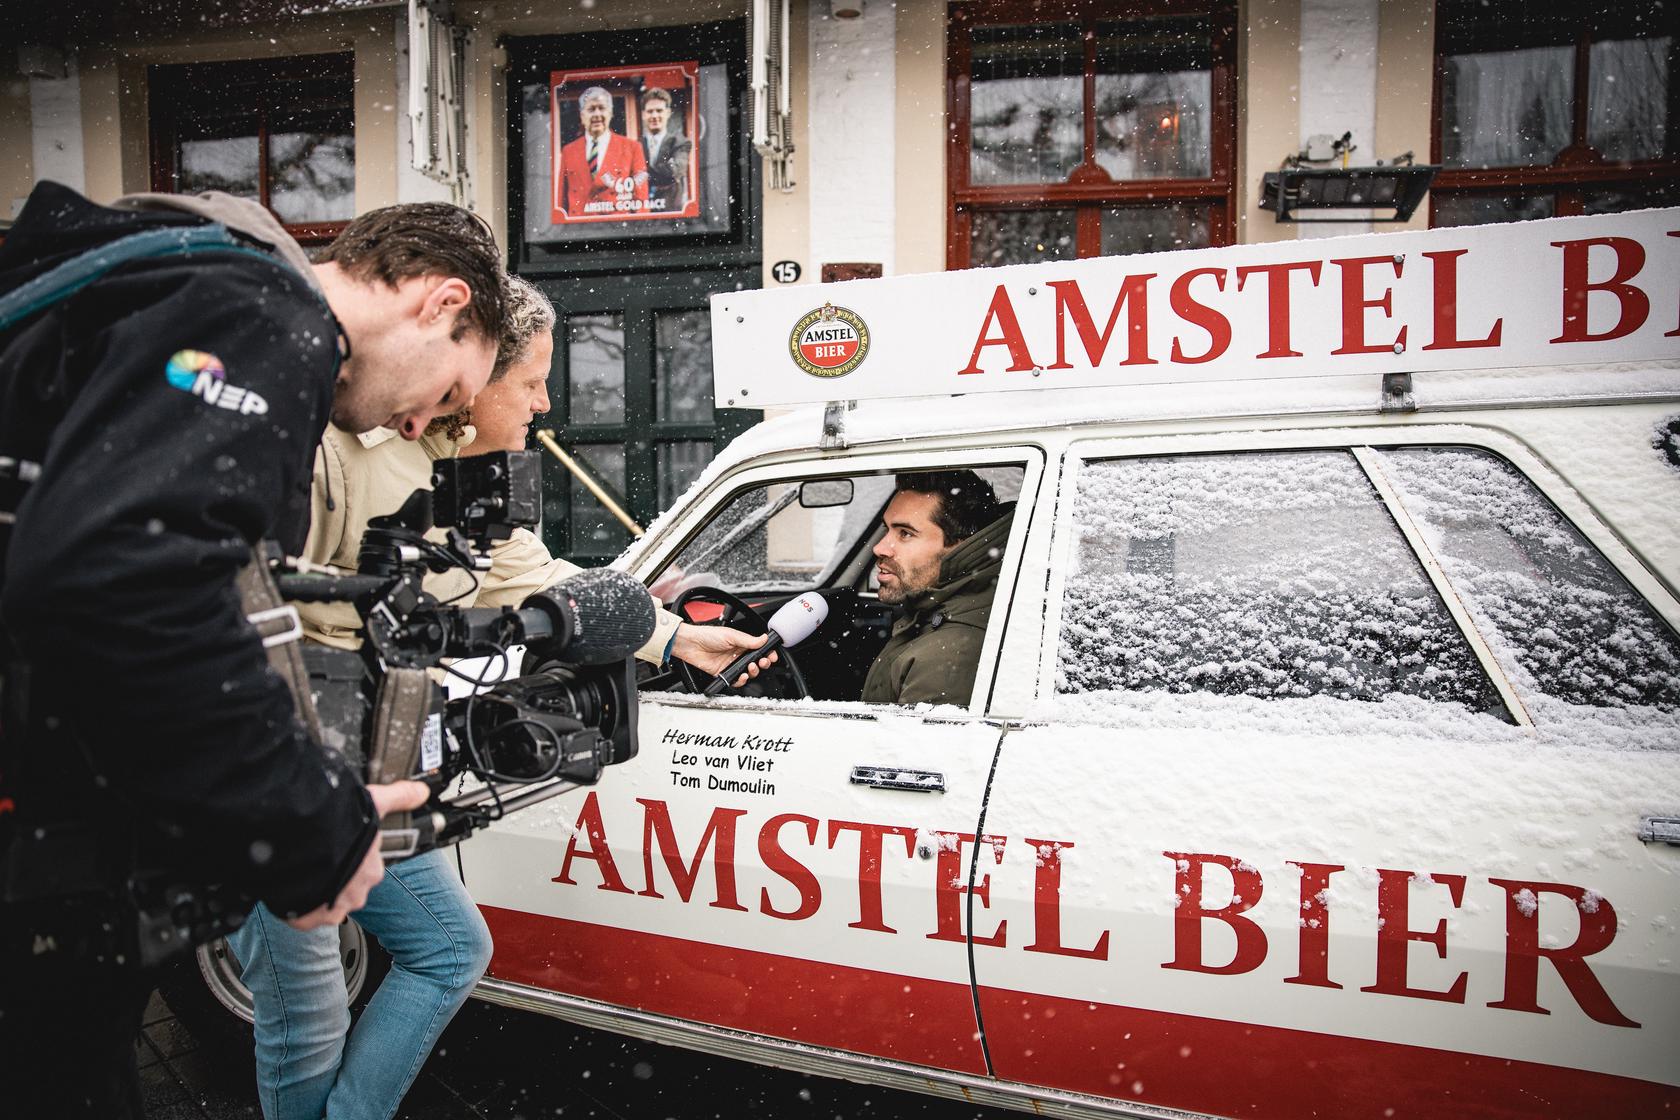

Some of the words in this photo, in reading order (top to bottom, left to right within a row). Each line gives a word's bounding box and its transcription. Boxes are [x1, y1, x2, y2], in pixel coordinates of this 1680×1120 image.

[614, 176, 635, 193] 60
[584, 201, 615, 213] AMSTEL
[615, 200, 643, 211] GOLD
[643, 198, 667, 209] RACE
[774, 262, 797, 283] 15
[958, 249, 1502, 376] AMSTEL
[805, 328, 854, 342] AMSTEL
[815, 345, 846, 358] BIER
[192, 371, 269, 415] NEP
[799, 599, 814, 612] NOS
[662, 728, 739, 749] Herman
[742, 734, 795, 753] Krott
[672, 750, 698, 766] Leo
[705, 756, 730, 769] van
[737, 755, 775, 773] Vliet
[670, 771, 700, 789] Tom
[708, 775, 776, 796] Dumoulin
[551, 791, 1110, 961] AMSTEL
[1161, 850, 1642, 1029] BIER
